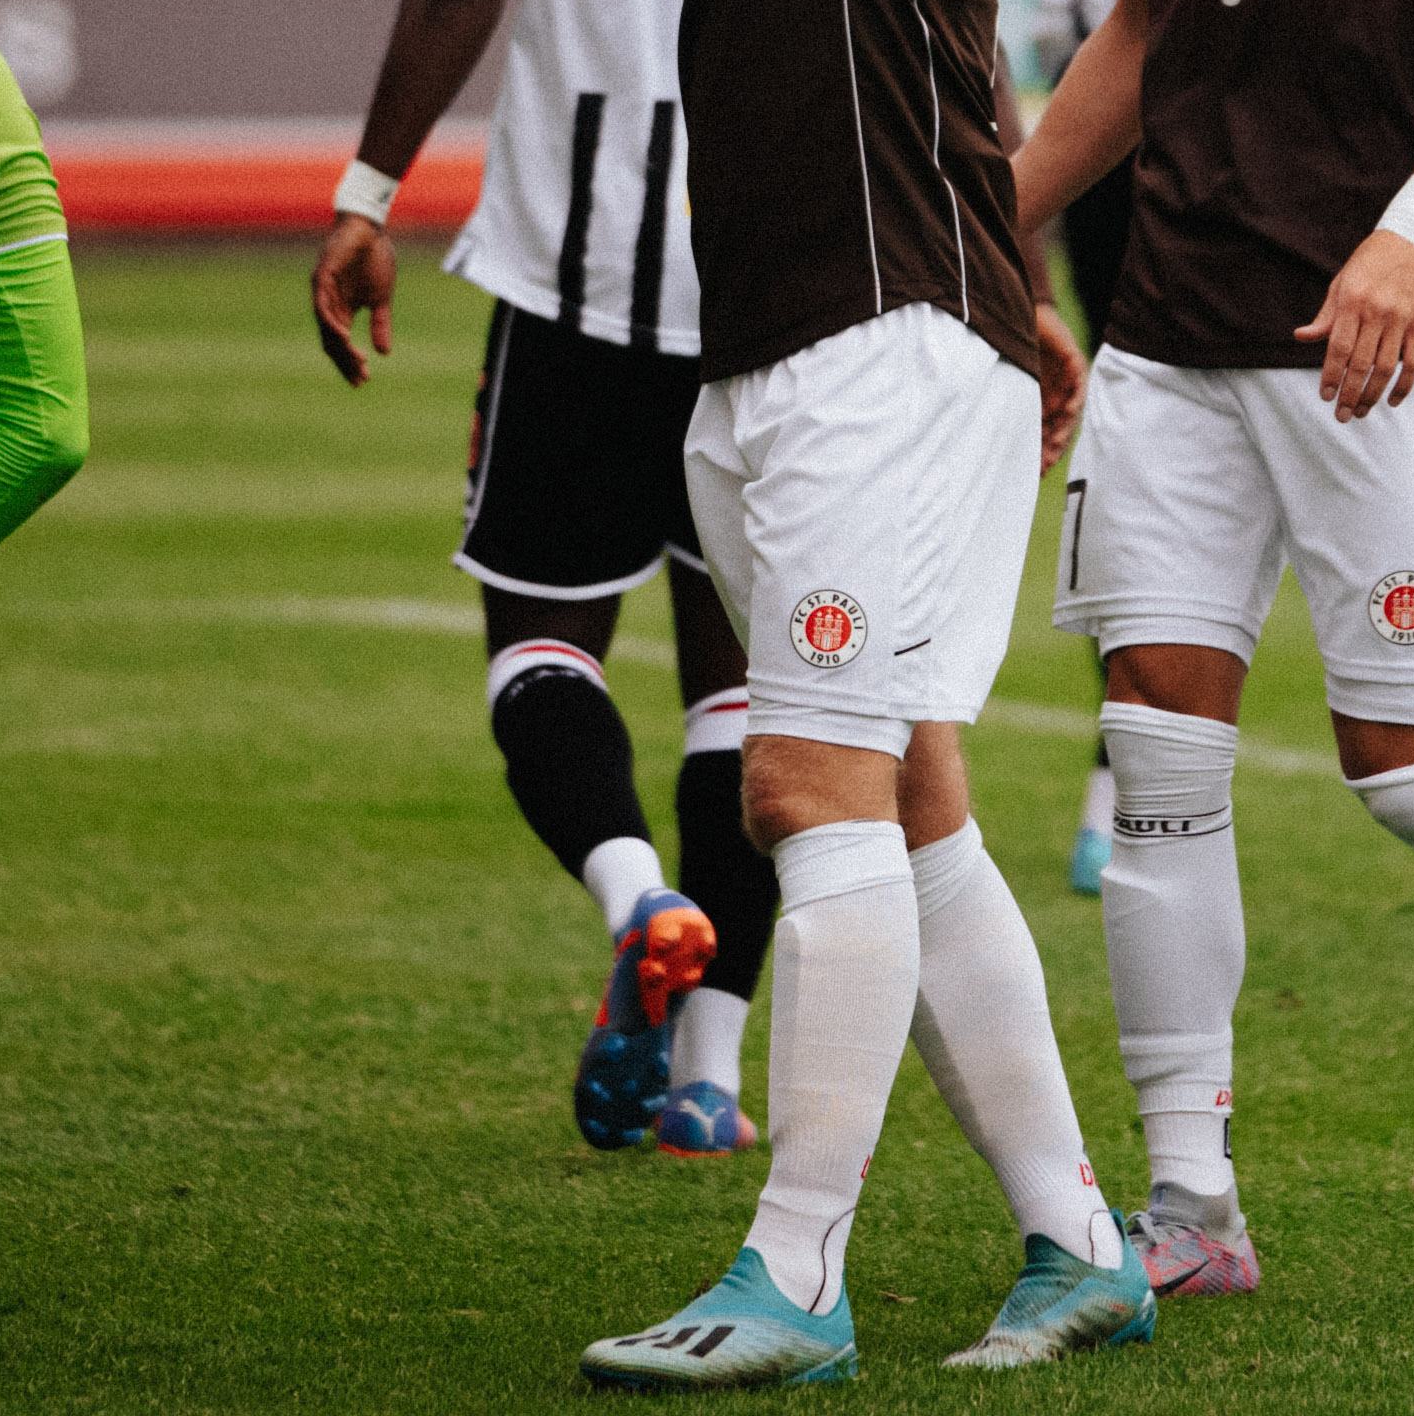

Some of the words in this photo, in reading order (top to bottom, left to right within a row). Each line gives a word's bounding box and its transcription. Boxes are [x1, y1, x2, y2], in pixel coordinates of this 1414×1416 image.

[1373, 591, 1385, 605] FC
[794, 608, 808, 625] FC
[831, 593, 865, 631] PAULI
[809, 651, 841, 665] 1910
